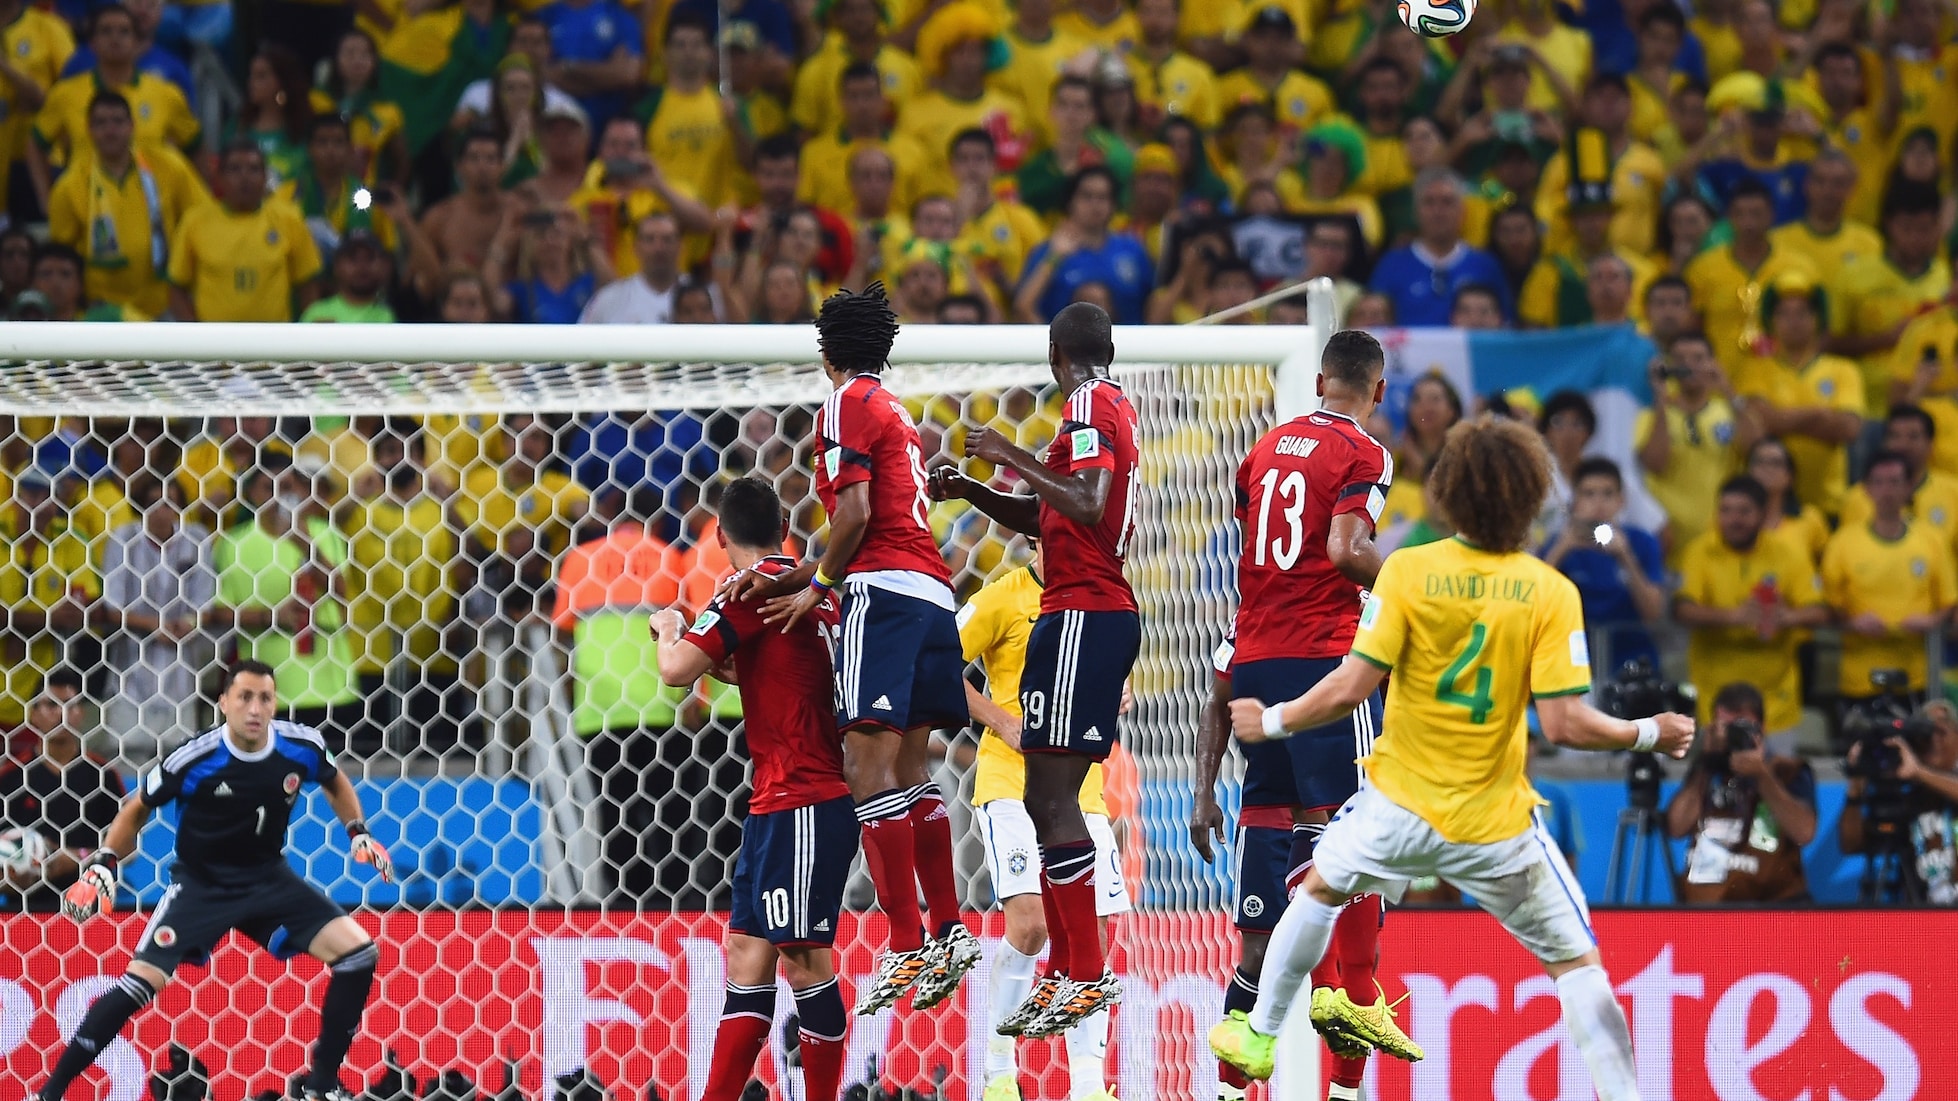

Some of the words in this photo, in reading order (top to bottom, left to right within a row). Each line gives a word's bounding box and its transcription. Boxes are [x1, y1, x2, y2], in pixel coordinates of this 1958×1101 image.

[1275, 436, 1320, 458] GUARIN
[1255, 468, 1306, 571] 13
[1426, 574, 1486, 599] DAVID
[1492, 578, 1535, 603] LUIZ
[1436, 623, 1494, 724] 4
[1021, 690, 1045, 730] 19
[256, 805, 266, 835] 1
[761, 887, 790, 930] 10
